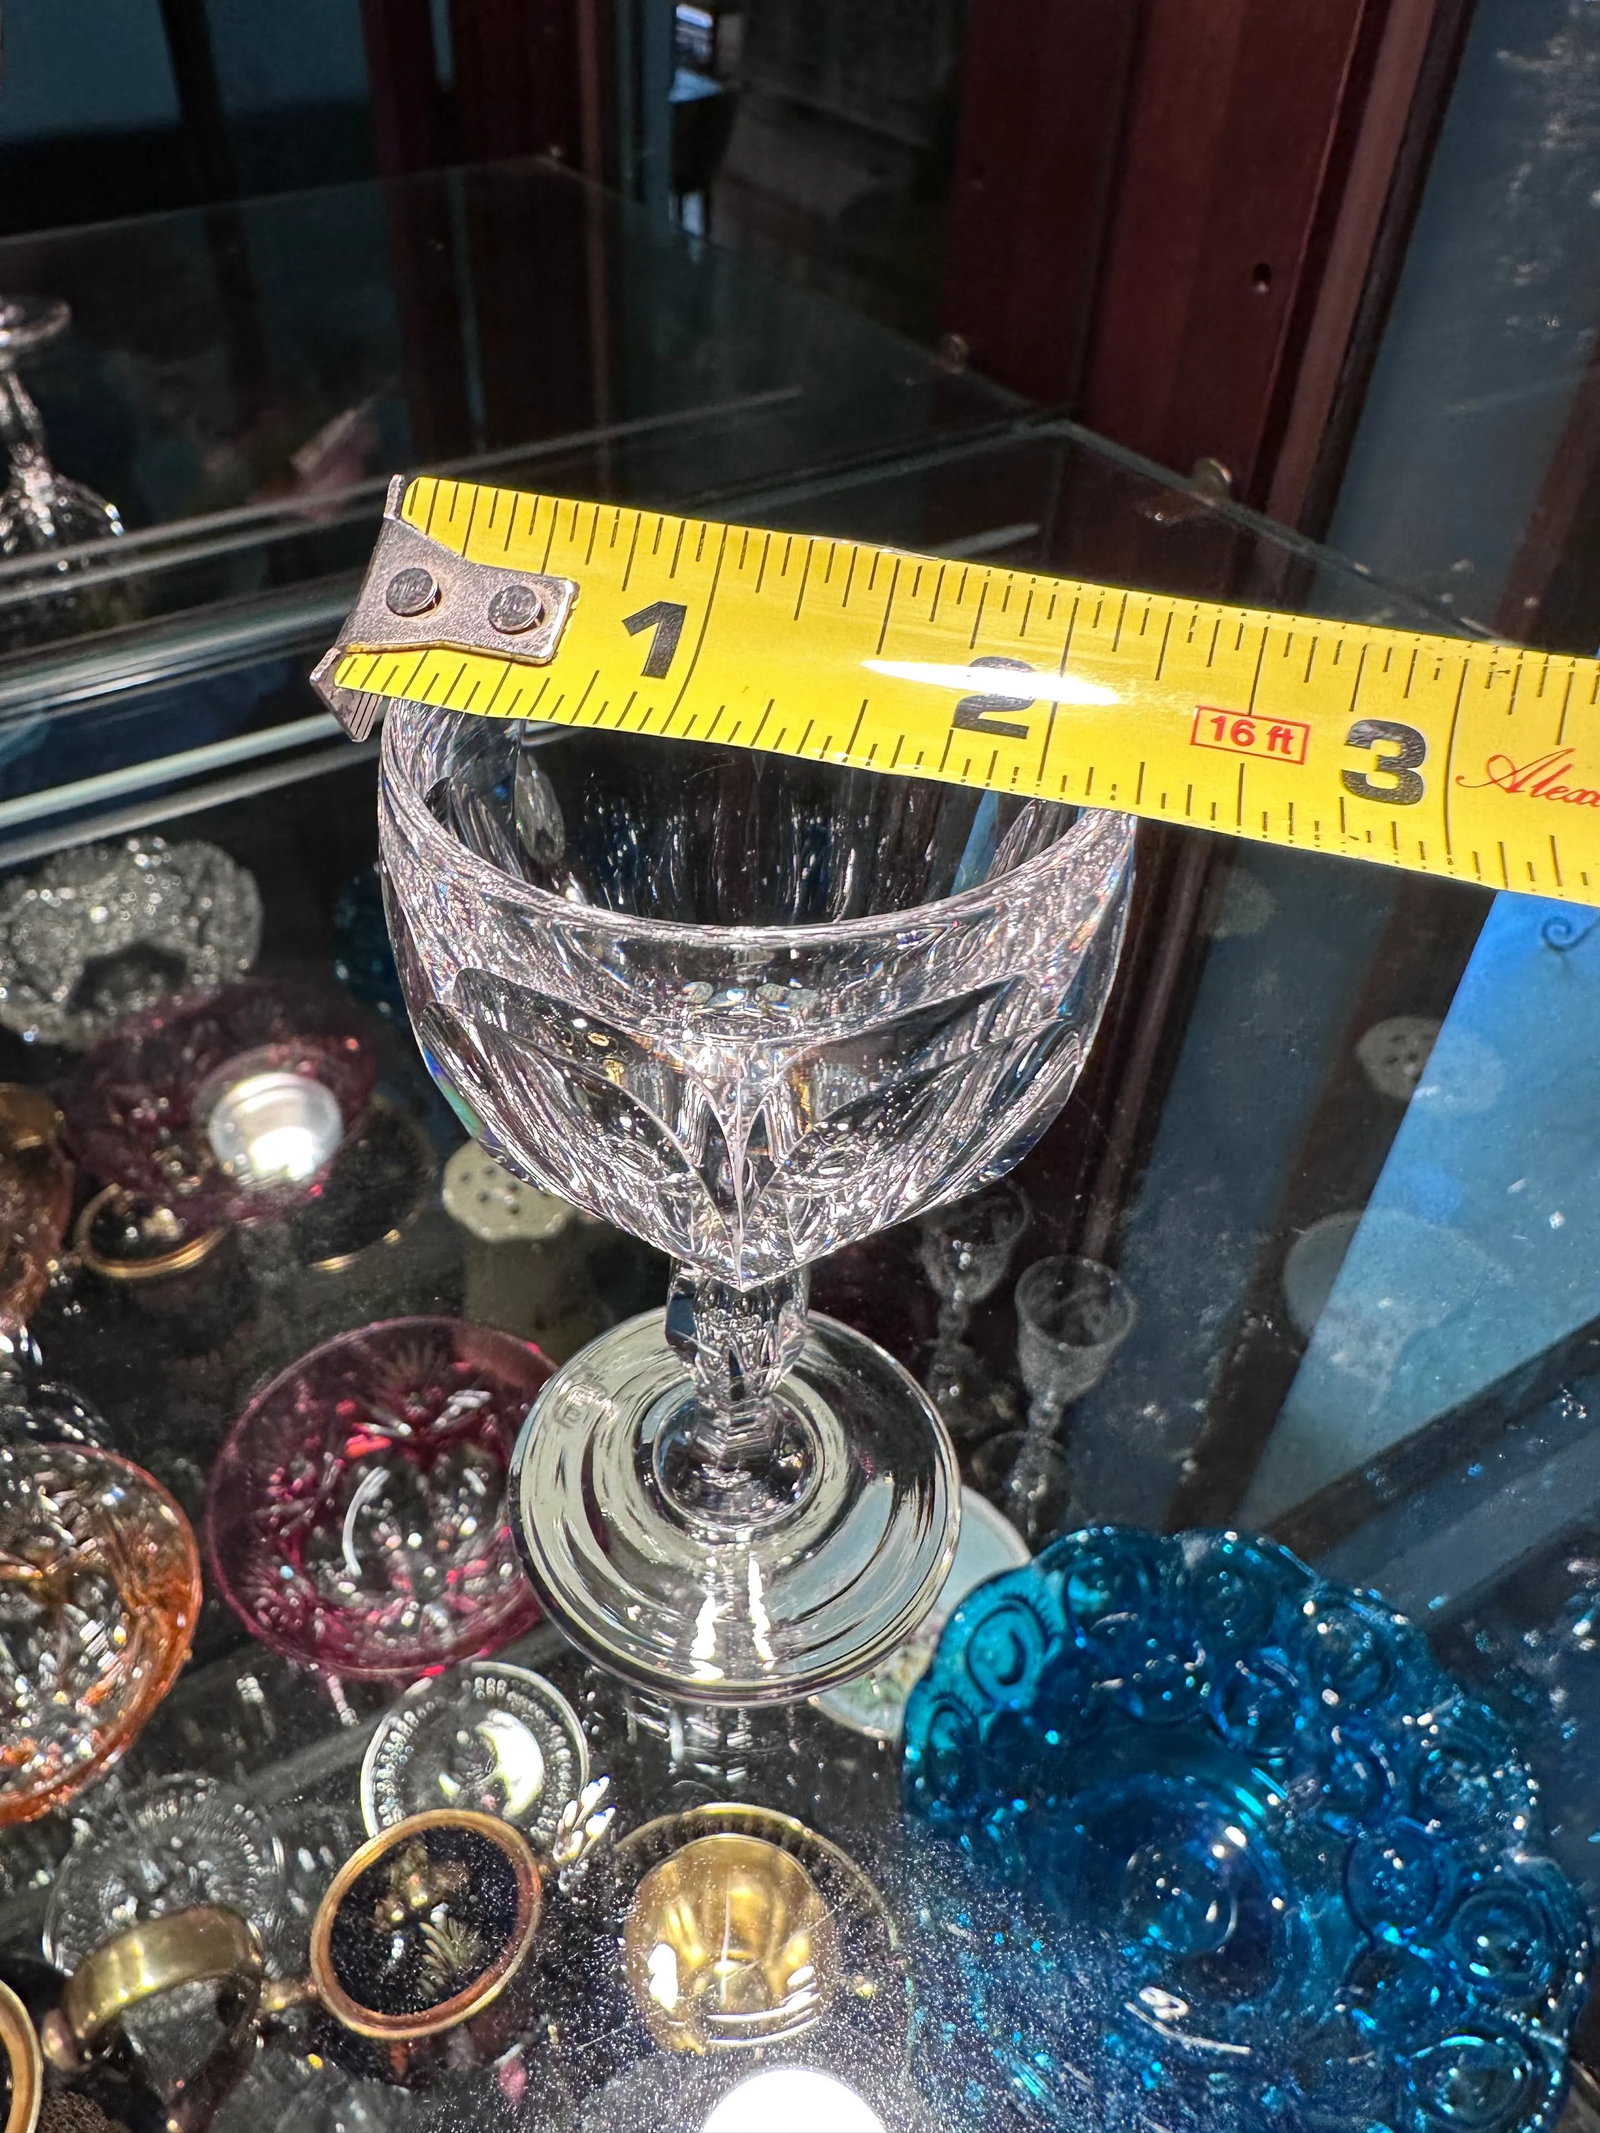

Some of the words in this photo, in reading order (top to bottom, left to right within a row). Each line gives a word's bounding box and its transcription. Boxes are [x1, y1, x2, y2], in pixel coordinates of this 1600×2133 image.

[621, 600, 688, 679] 1
[951, 656, 1037, 740] 2
[1209, 715, 1256, 747] 16
[1266, 724, 1295, 755] ft
[1341, 719, 1427, 806] 3
